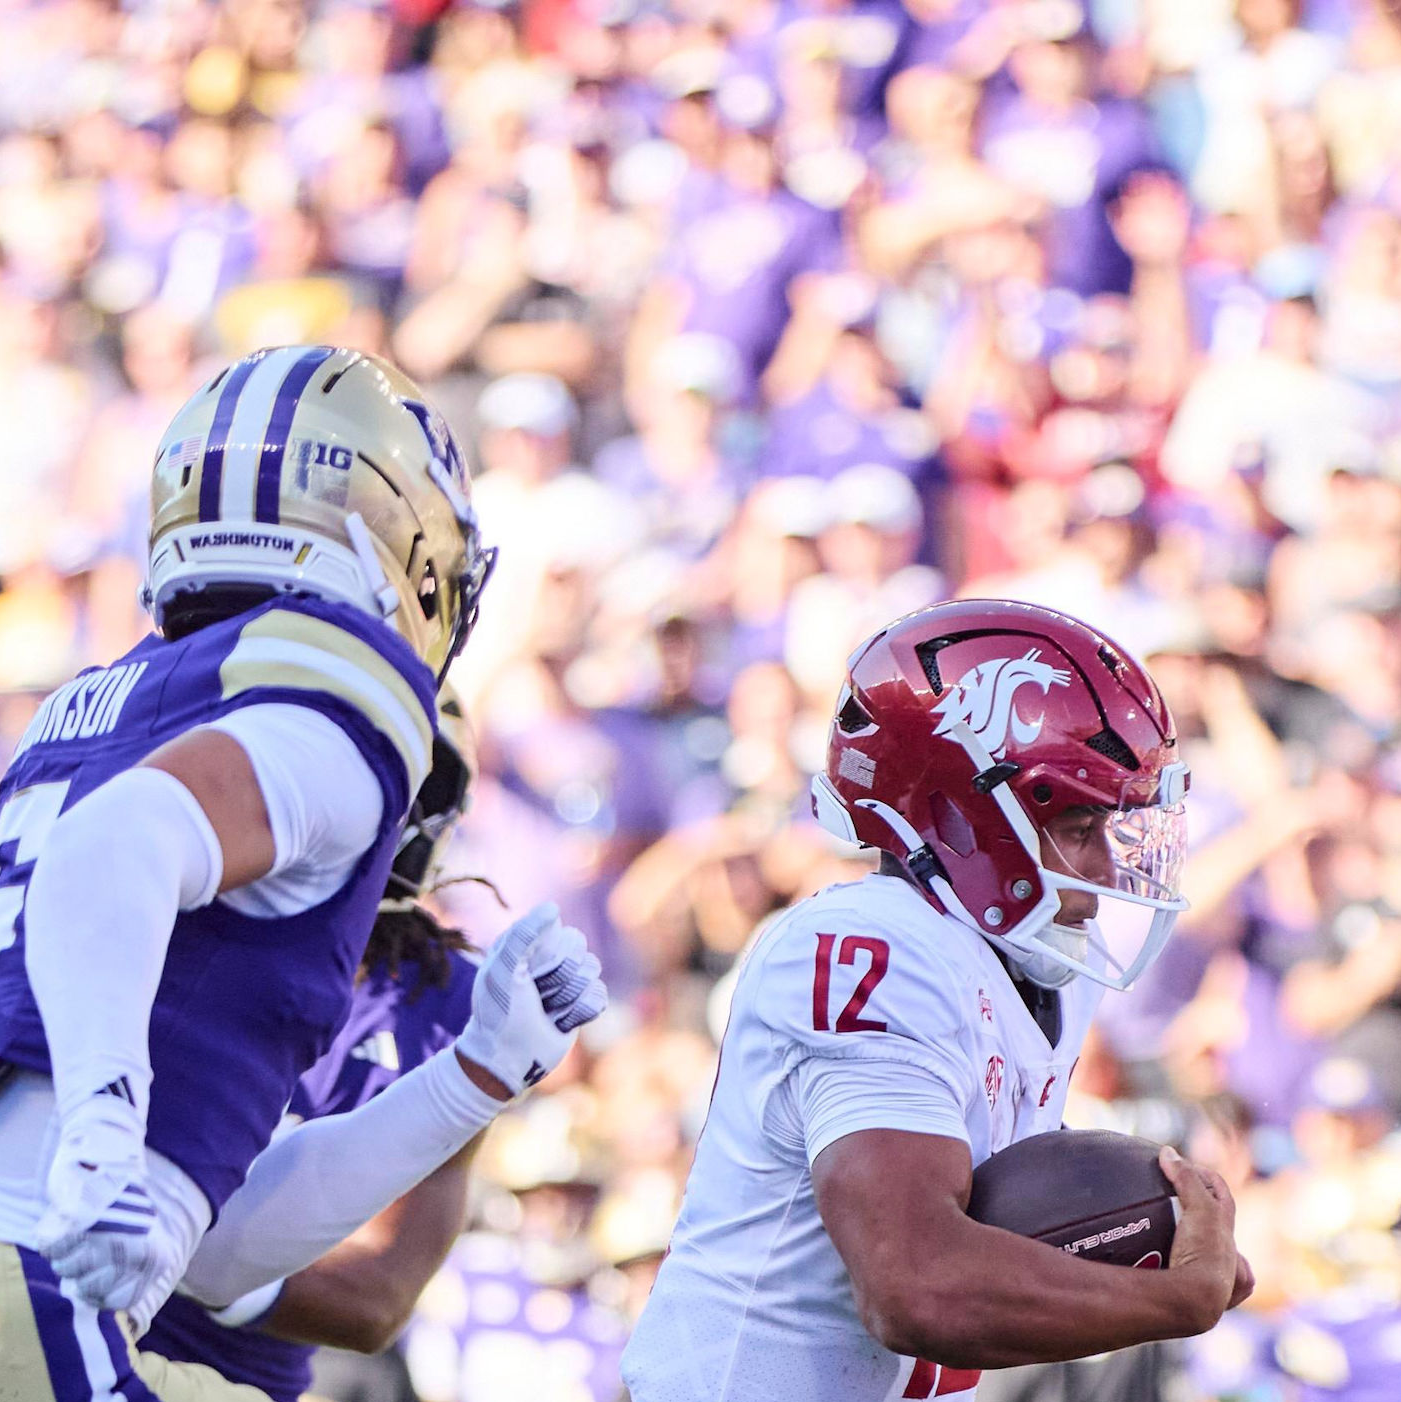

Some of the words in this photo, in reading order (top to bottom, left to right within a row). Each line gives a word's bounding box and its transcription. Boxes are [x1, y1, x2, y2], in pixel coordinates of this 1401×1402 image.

[190, 532, 294, 551] WASHINGTON
[812, 932, 890, 1034] 12
[1100, 1217, 1151, 1244] VAPOR
[1058, 1234, 1101, 1255] ELIT
